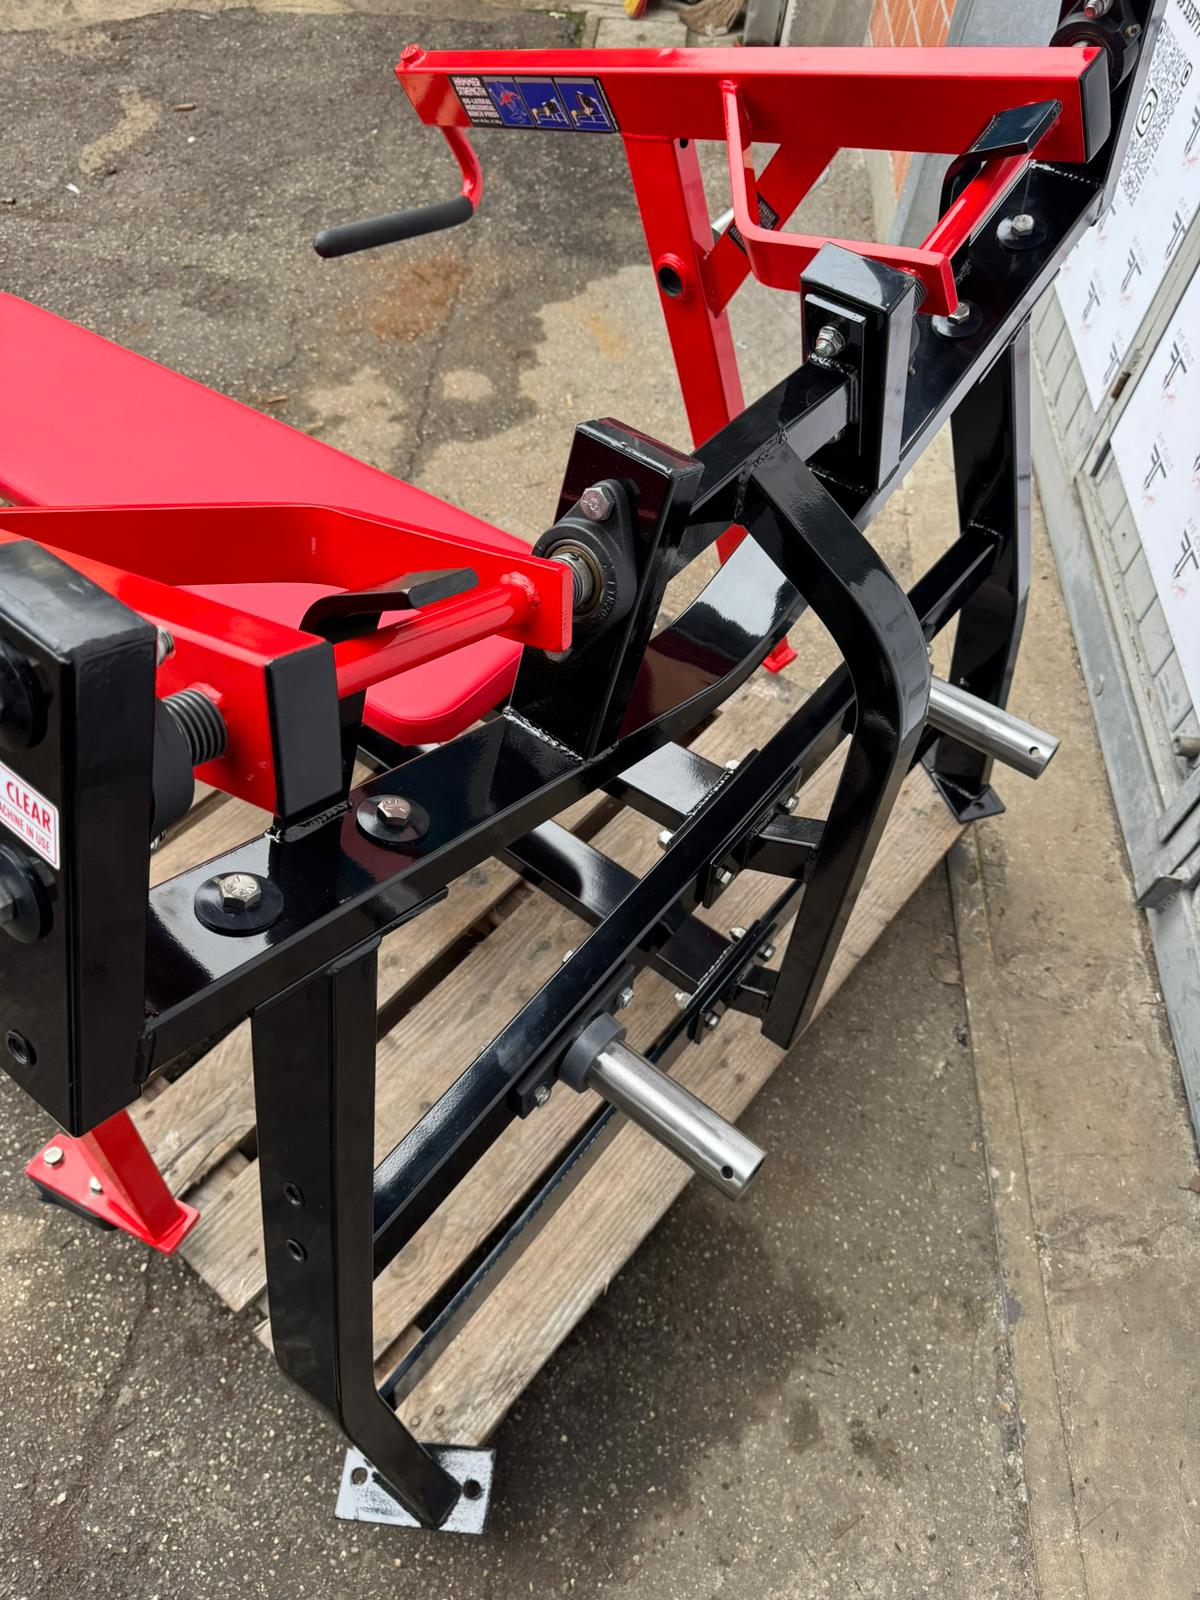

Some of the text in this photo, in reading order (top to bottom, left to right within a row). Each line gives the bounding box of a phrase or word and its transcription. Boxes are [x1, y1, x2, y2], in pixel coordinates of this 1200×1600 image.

[6, 781, 51, 833] CLEAR
[26, 823, 34, 840] IN
[36, 833, 50, 853] USE
